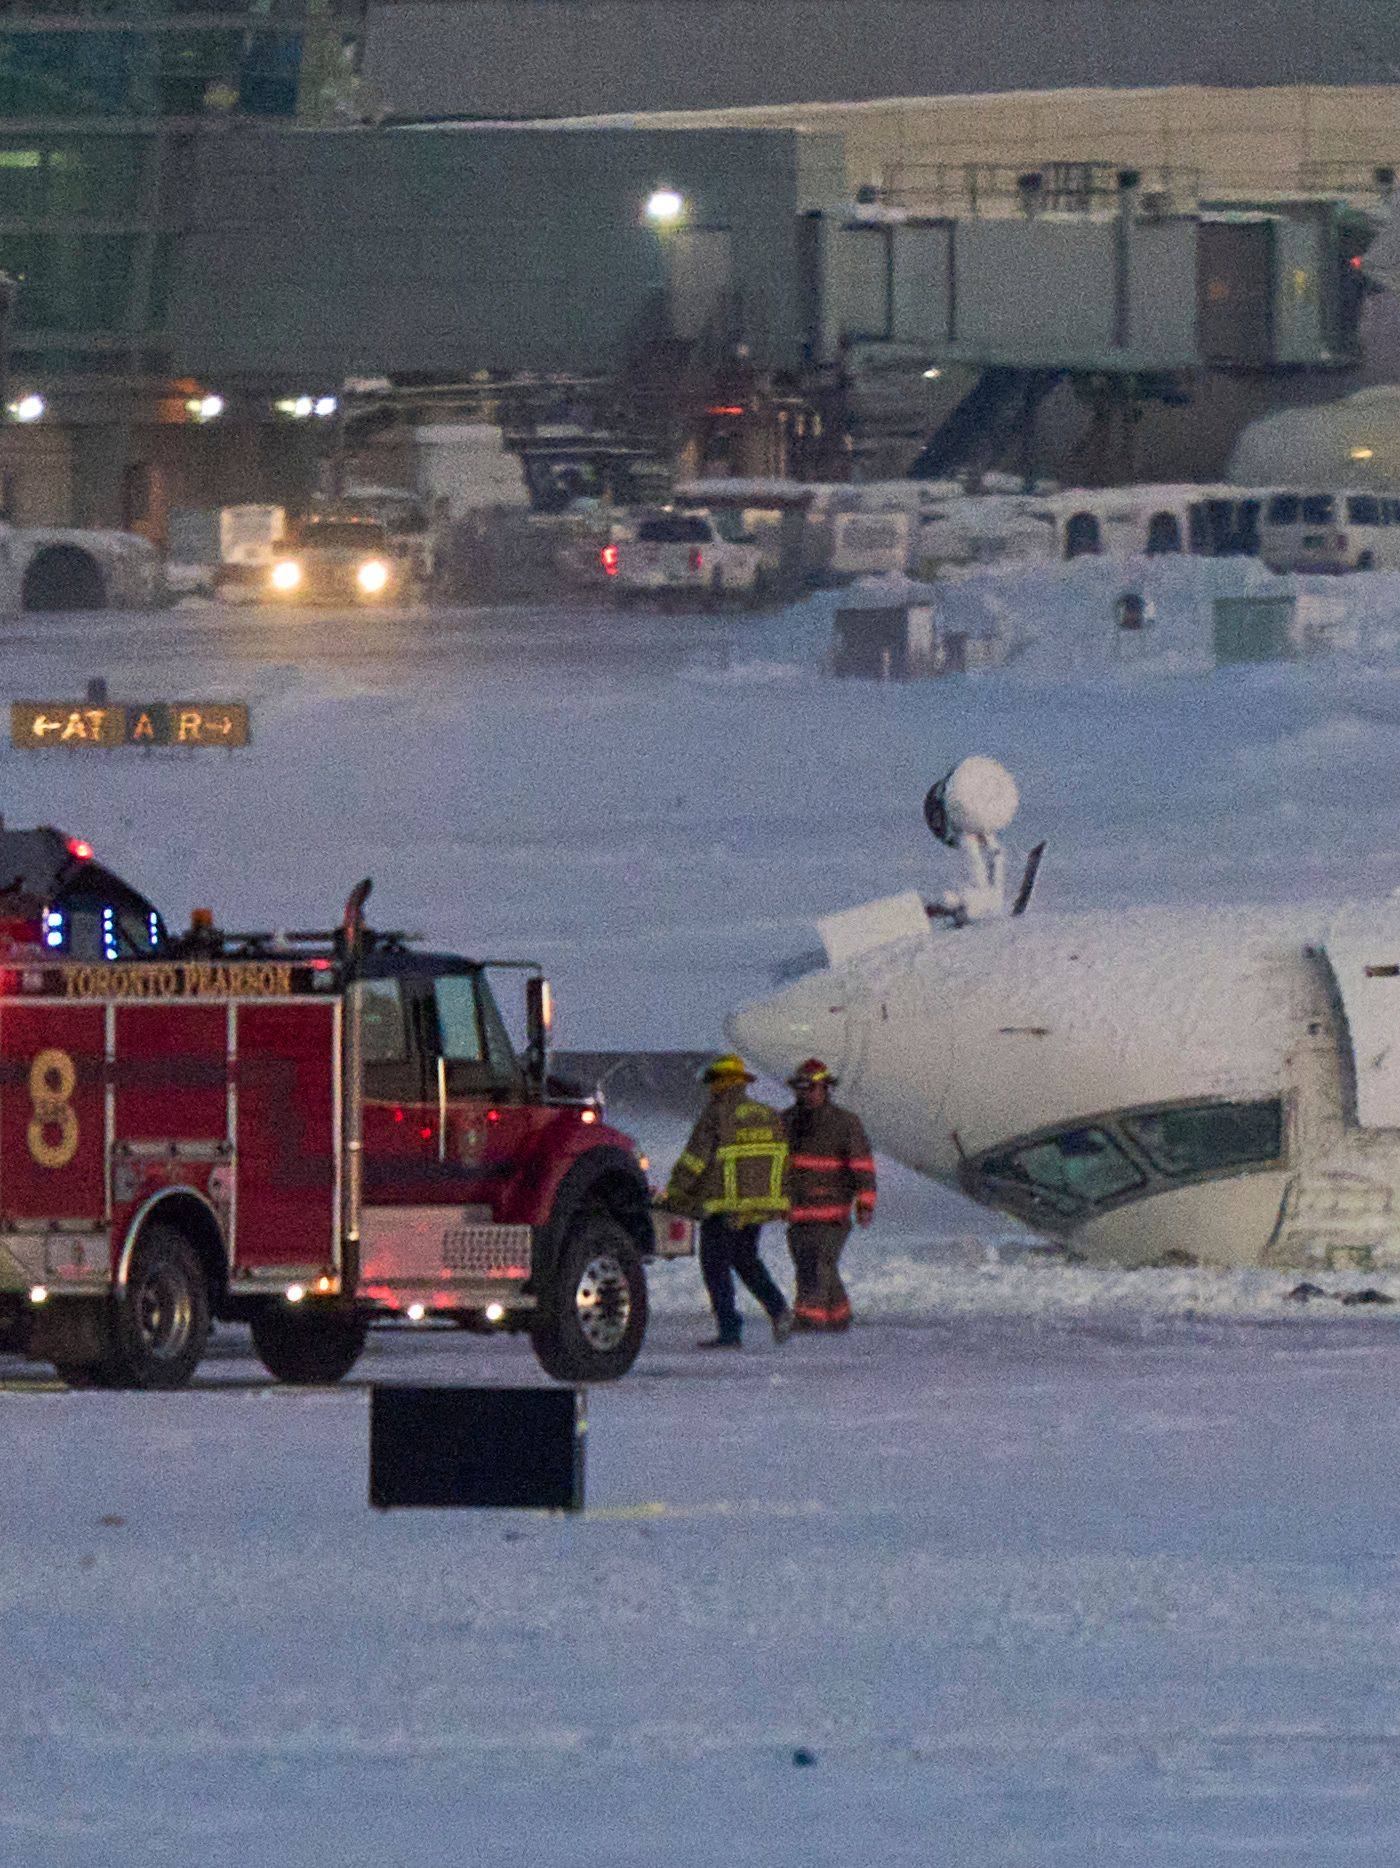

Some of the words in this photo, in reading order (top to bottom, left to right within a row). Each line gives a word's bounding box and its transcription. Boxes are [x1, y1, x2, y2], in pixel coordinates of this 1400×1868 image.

[132, 712, 155, 740] A
[177, 711, 203, 741] R
[63, 962, 177, 998] TORONTO
[183, 960, 293, 997] PEARSON
[28, 1047, 79, 1169] 8
